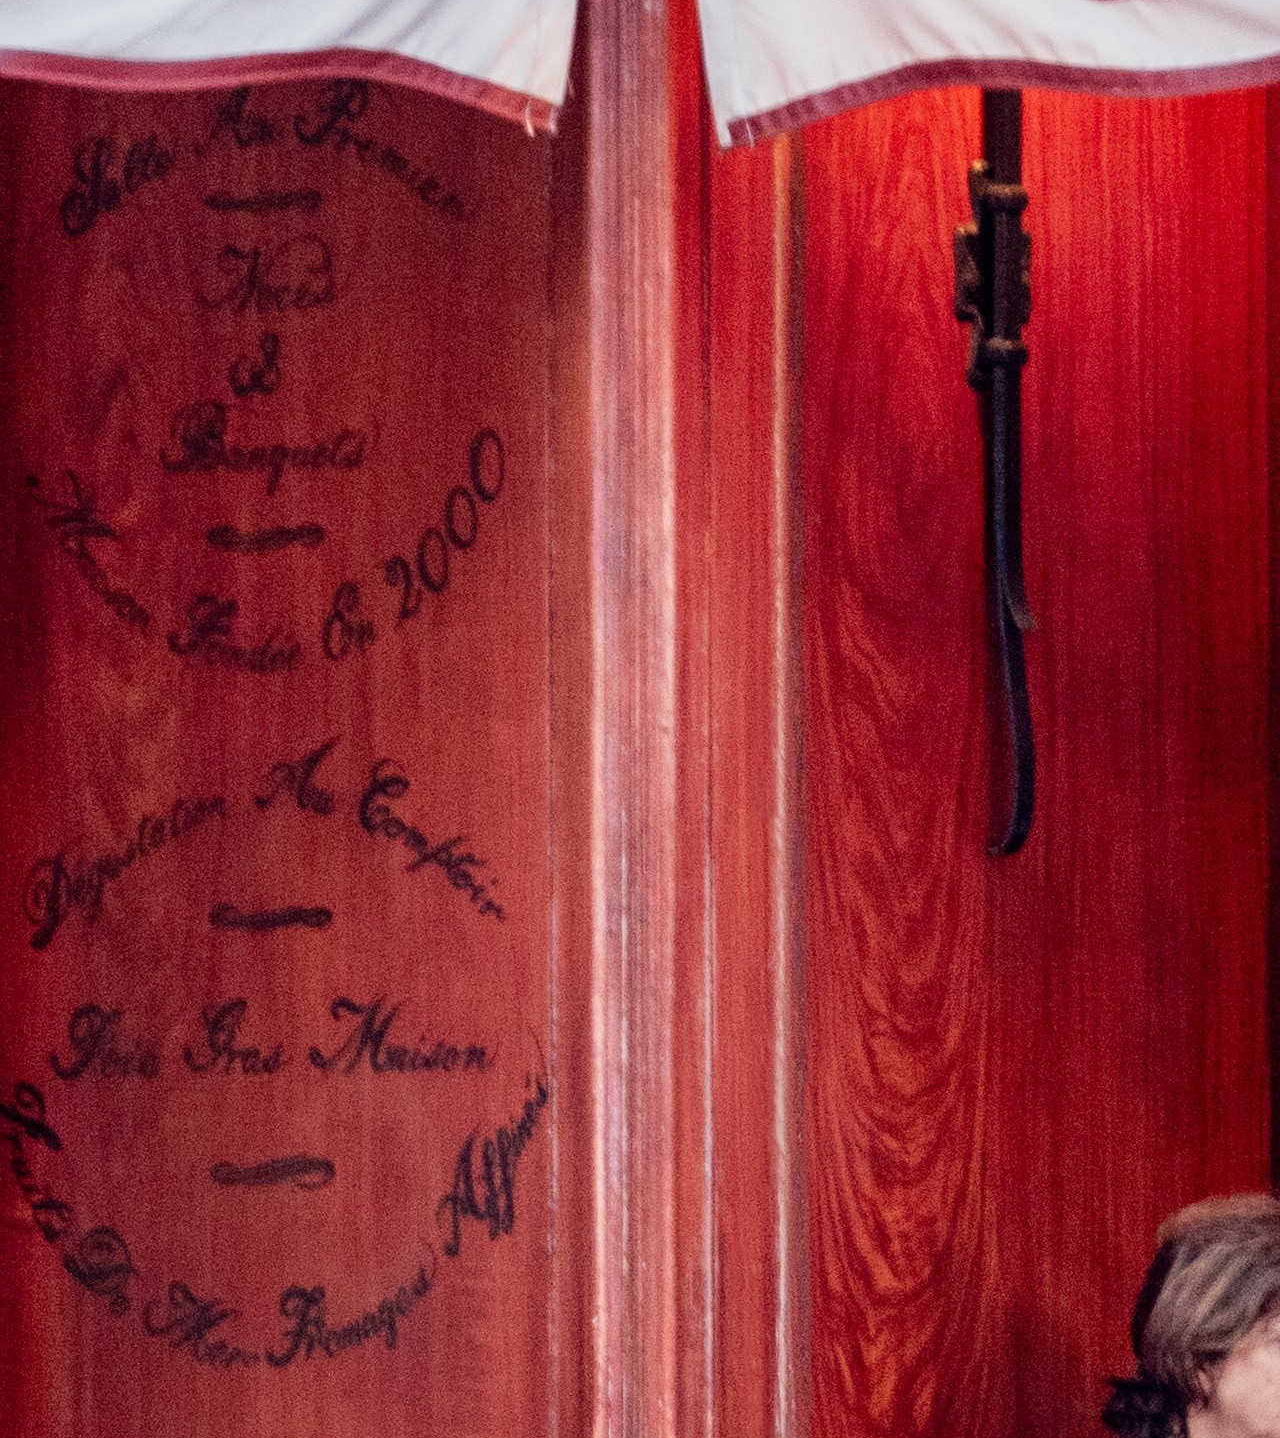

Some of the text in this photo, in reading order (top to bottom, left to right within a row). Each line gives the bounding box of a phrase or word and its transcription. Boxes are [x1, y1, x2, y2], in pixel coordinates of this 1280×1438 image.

[384, 427, 506, 621] 2000
[255, 735, 340, 815] Au
[359, 758, 506, 921] Comptoir
[50, 996, 495, 1080] Foie Gras Maison
[144, 1281, 263, 1367] Mer
[265, 1242, 437, 1367] Fromages
